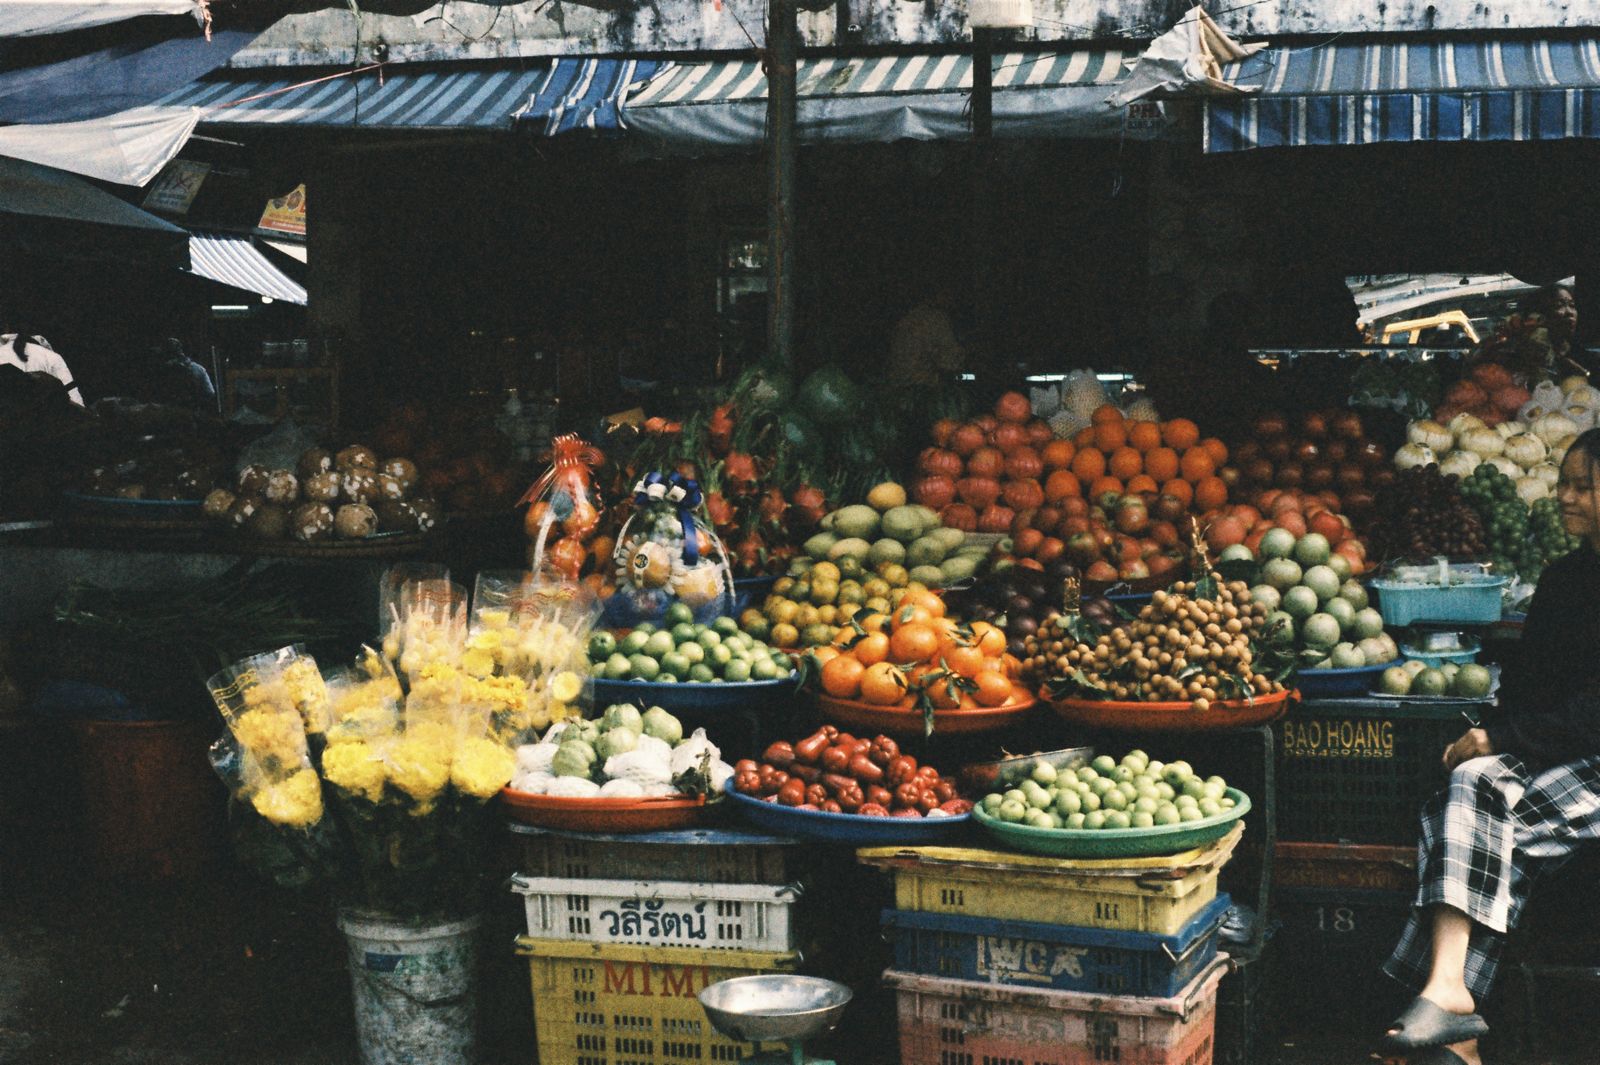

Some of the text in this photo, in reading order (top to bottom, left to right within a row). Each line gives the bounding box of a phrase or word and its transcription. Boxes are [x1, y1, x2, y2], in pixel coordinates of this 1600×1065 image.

[1284, 720, 1393, 749] BAO HOANG
[599, 898, 707, 940] วลีรัตน์
[1316, 906, 1355, 932] 18
